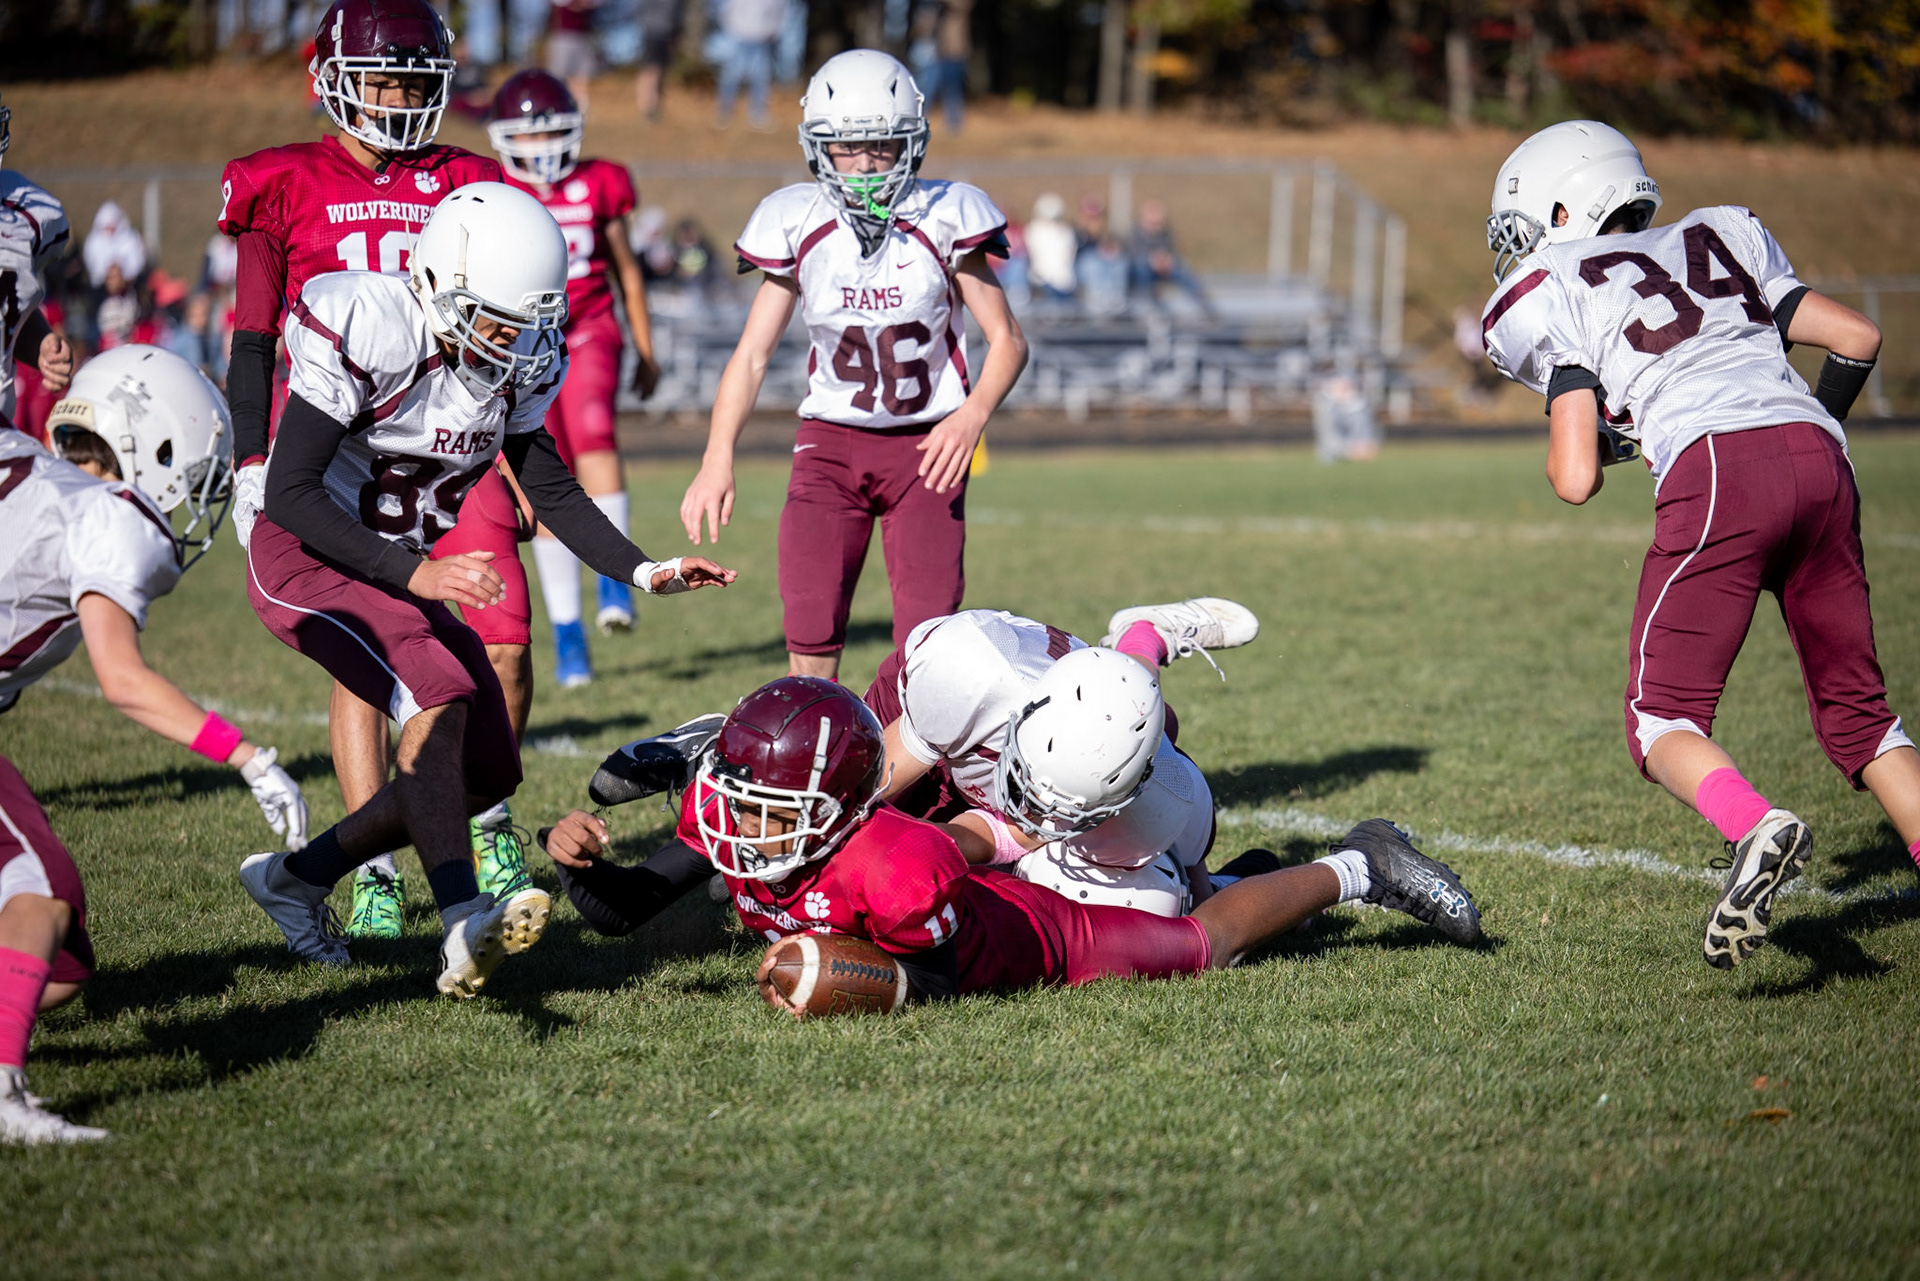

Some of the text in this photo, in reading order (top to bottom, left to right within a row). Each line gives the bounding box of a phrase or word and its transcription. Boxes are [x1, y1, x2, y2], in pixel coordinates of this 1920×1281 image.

[841, 286, 902, 310] RAMS
[1579, 222, 1774, 355] 34
[832, 320, 932, 416] 46
[430, 428, 497, 454] RAMS
[924, 901, 959, 948] 11
